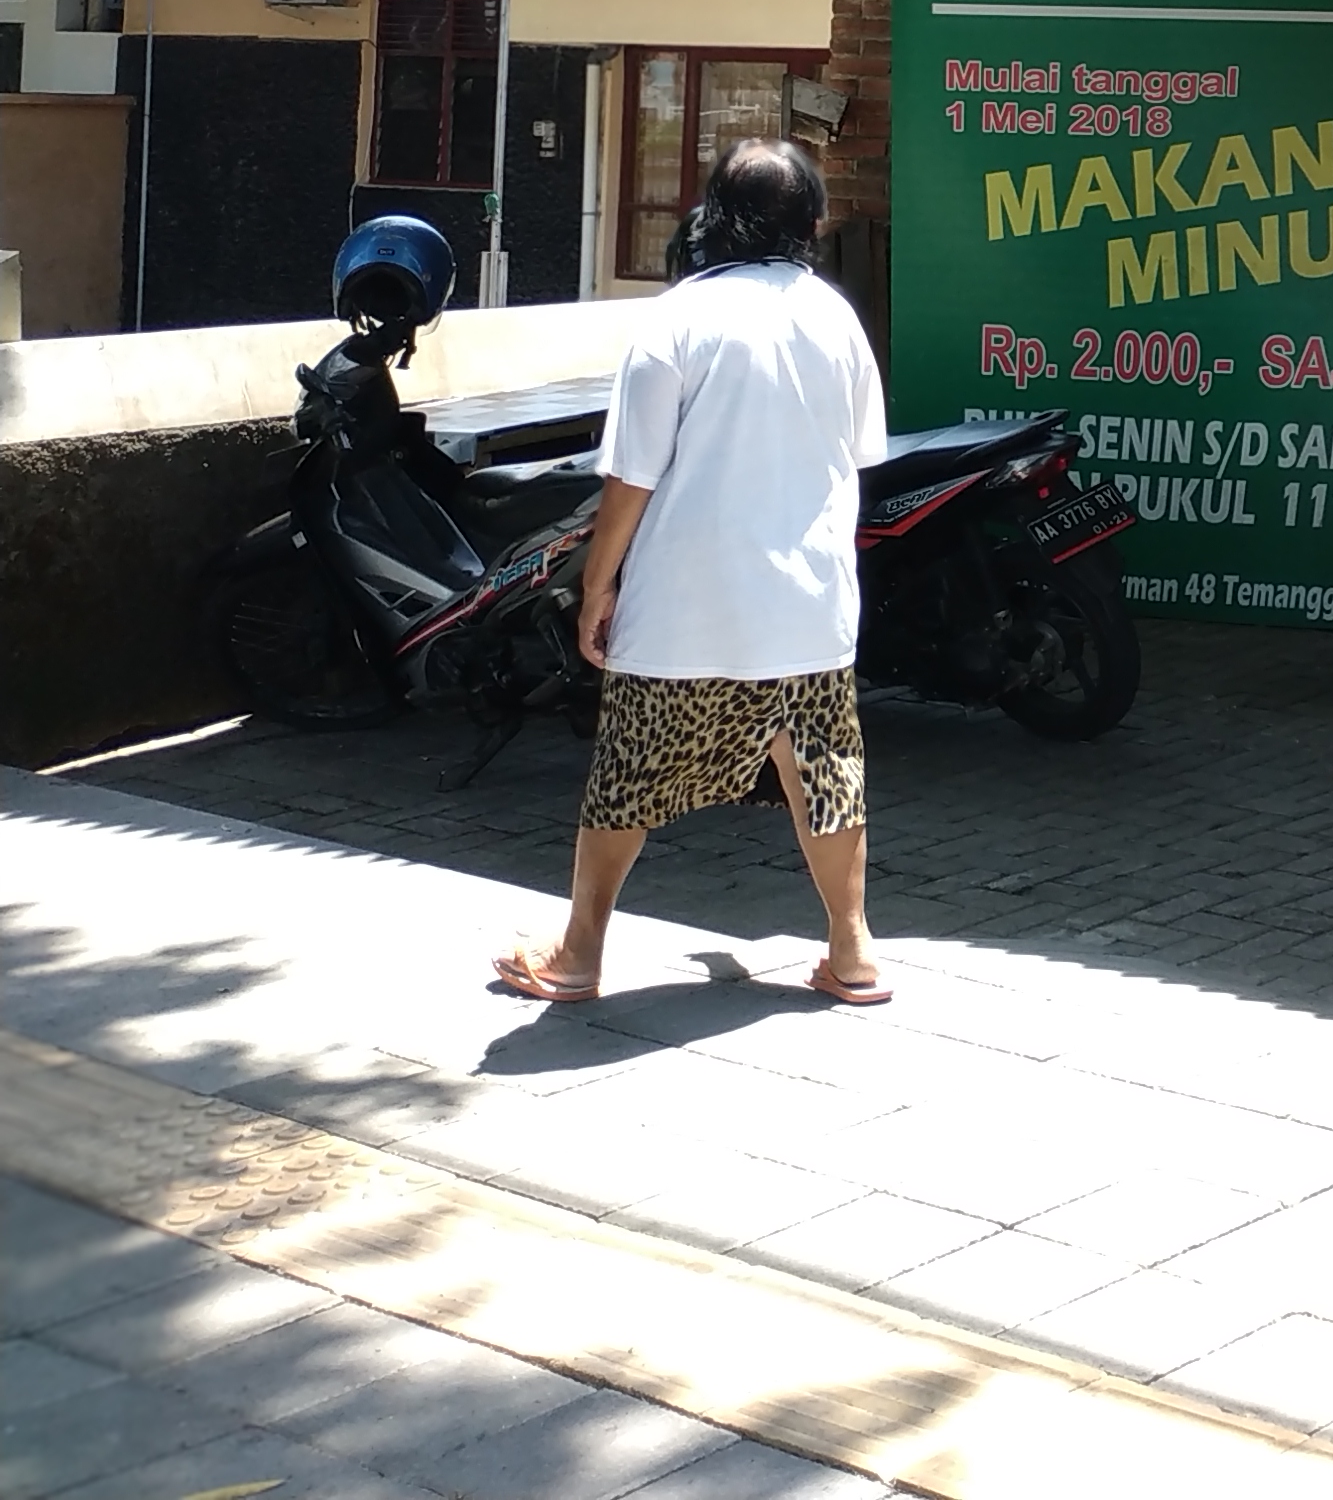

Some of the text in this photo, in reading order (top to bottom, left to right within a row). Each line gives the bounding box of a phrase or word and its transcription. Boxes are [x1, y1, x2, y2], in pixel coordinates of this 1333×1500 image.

[945, 59, 1240, 104] Mulai tanggal
[945, 101, 1173, 138] 1 Mei 2018
[981, 323, 1058, 390] Rp.
[1070, 328, 1235, 396] 2.000,-
[1078, 413, 1194, 465] SENIN
[1202, 419, 1270, 480] S/D
[1033, 520, 1060, 544] AA
[1056, 500, 1097, 530] 3776
[1115, 474, 1256, 526] PUKUL
[1121, 574, 1178, 603] man
[1184, 572, 1217, 605] 48
